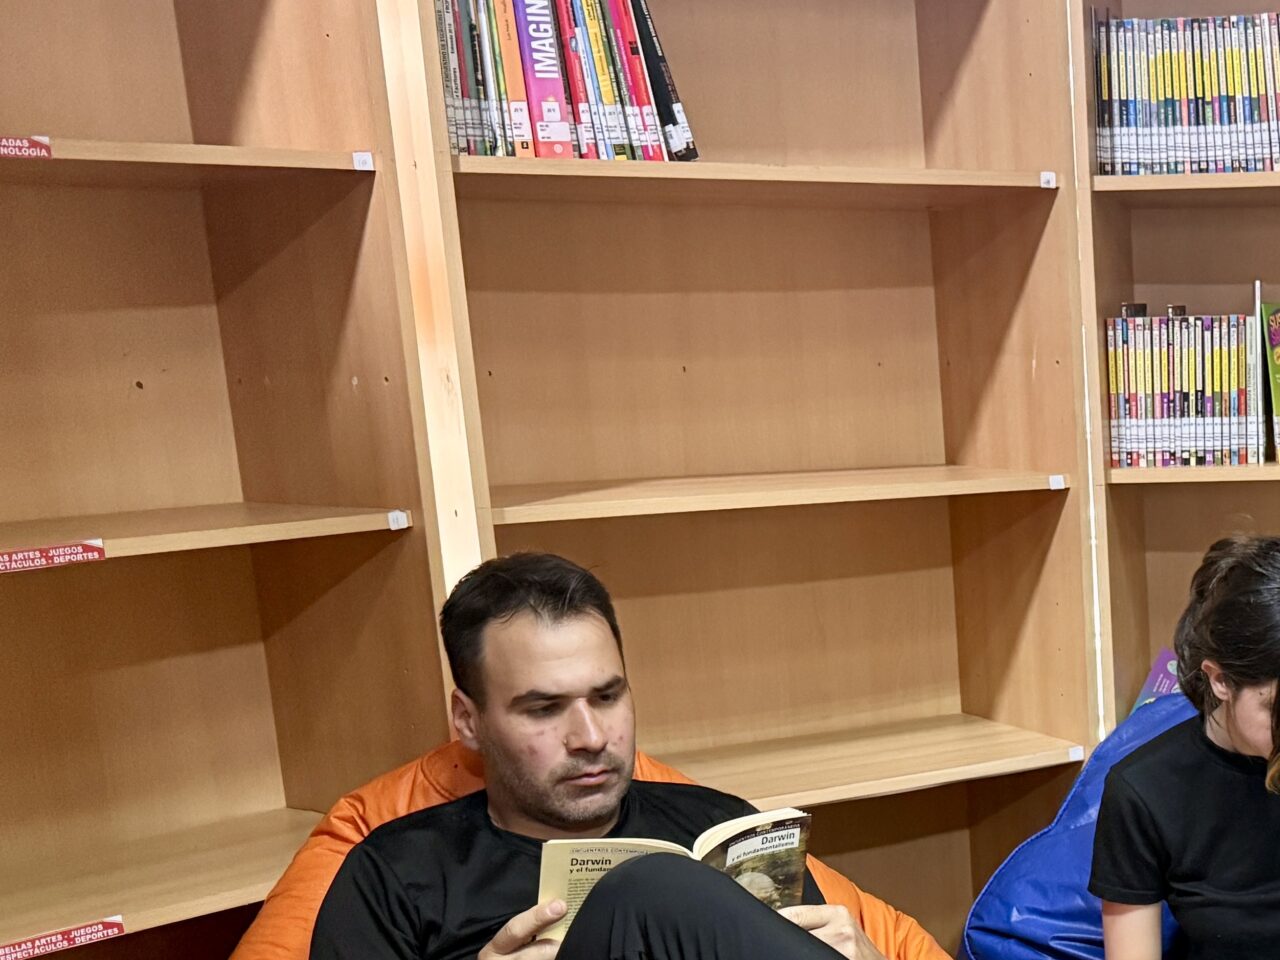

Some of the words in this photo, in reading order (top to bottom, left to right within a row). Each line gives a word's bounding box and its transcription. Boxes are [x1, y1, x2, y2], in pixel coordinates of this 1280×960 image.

[12, 550, 41, 561] ARTES
[48, 546, 83, 556] JUEGOS
[53, 552, 99, 563] DEPORTES
[761, 831, 795, 846] Darwin
[743, 842, 794, 857] fundamentalismo
[571, 857, 611, 866] Darwin
[0, 942, 32, 955] BELLAS
[35, 934, 62, 947] ARTES
[70, 924, 103, 938] JUEGOS
[76, 928, 119, 944] DEPORTES
